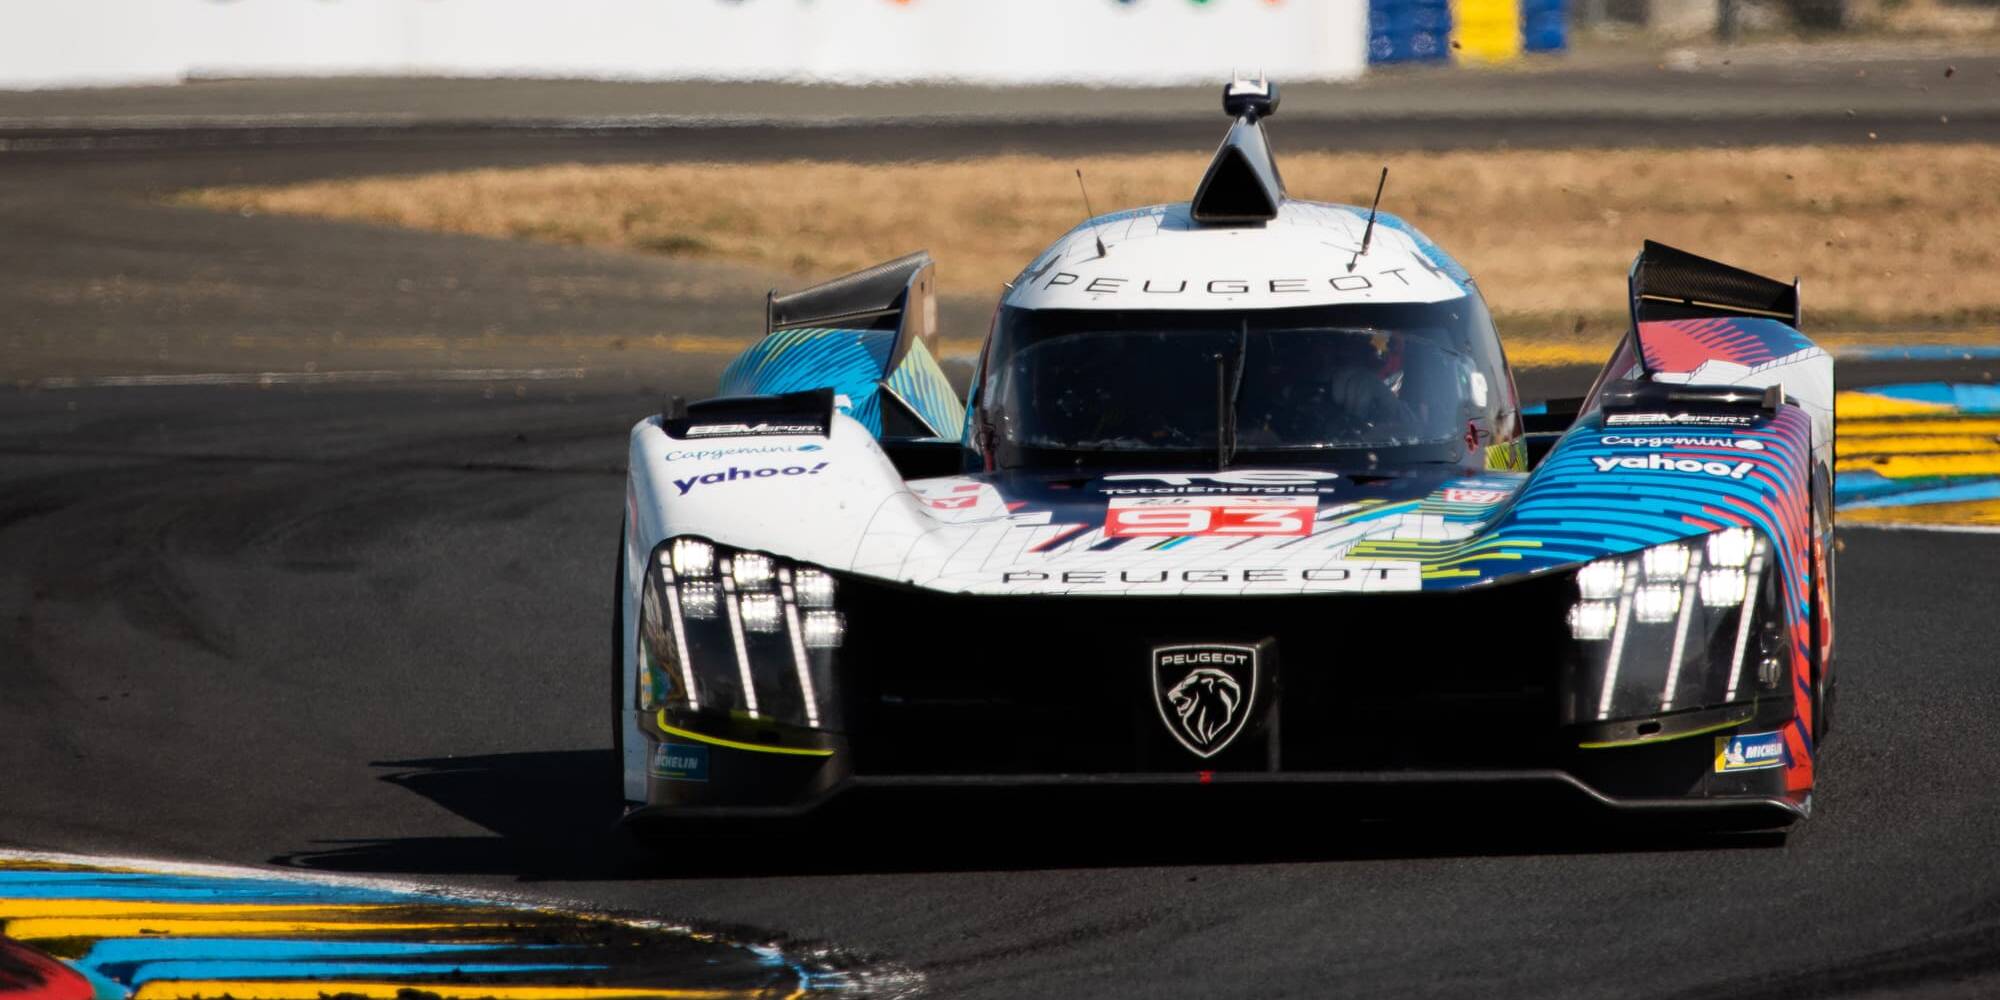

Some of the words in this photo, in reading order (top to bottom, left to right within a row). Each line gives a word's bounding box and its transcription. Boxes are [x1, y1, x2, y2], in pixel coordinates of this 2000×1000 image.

[1044, 269, 1409, 294] PEUGEOT
[1601, 436, 1733, 447] Capgemini
[666, 444, 793, 462] Capgemini
[1592, 454, 1754, 479] yahoo!
[673, 462, 830, 496] yahoo!
[1099, 486, 1335, 495] TotalEnergies
[1118, 508, 1303, 533] 93
[1002, 567, 1408, 584] PEUGEOT
[1161, 653, 1247, 665] PEUGEOT
